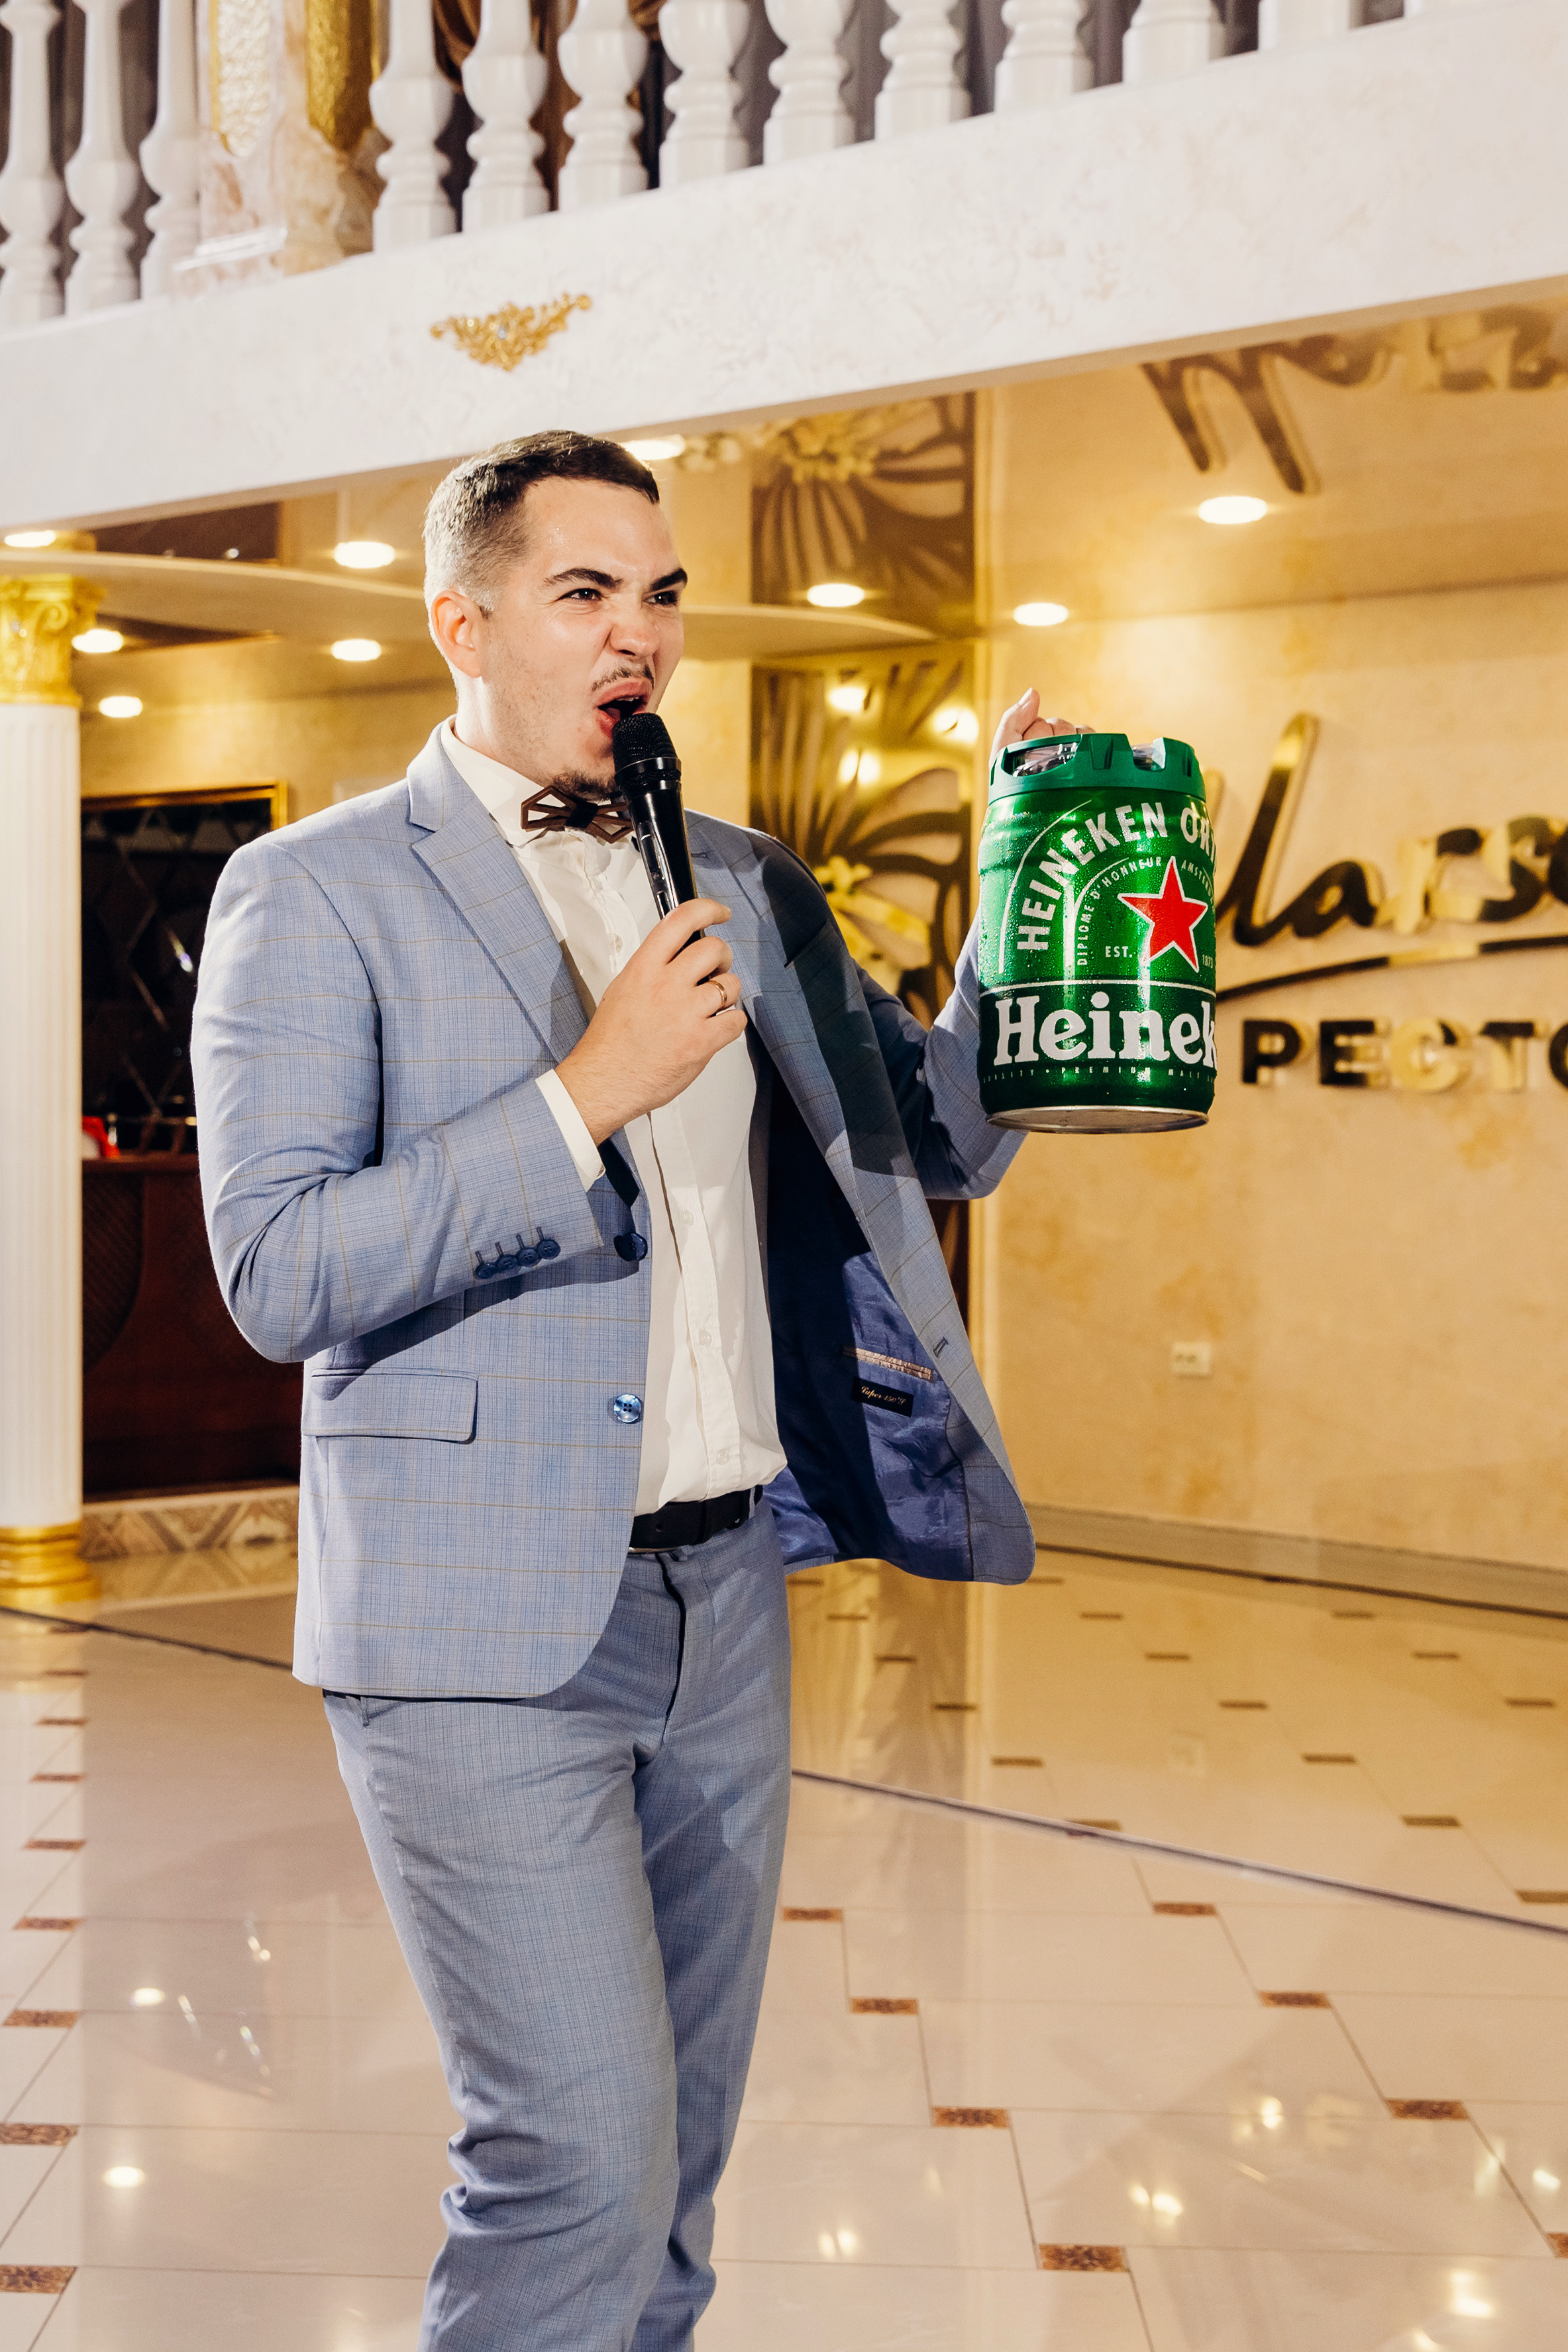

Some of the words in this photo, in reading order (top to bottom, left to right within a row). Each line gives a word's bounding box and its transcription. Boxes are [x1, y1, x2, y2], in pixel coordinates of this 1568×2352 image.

[1017, 802, 1168, 950] HEINEKEN
[1180, 807, 1216, 868] ORI
[1076, 904, 1095, 966] DIPLOME
[1090, 857, 1161, 900] D'HONNEUR
[1105, 945, 1133, 958] EST.
[1202, 954, 1214, 969] 1873
[861, 1385, 882, 1399] Super
